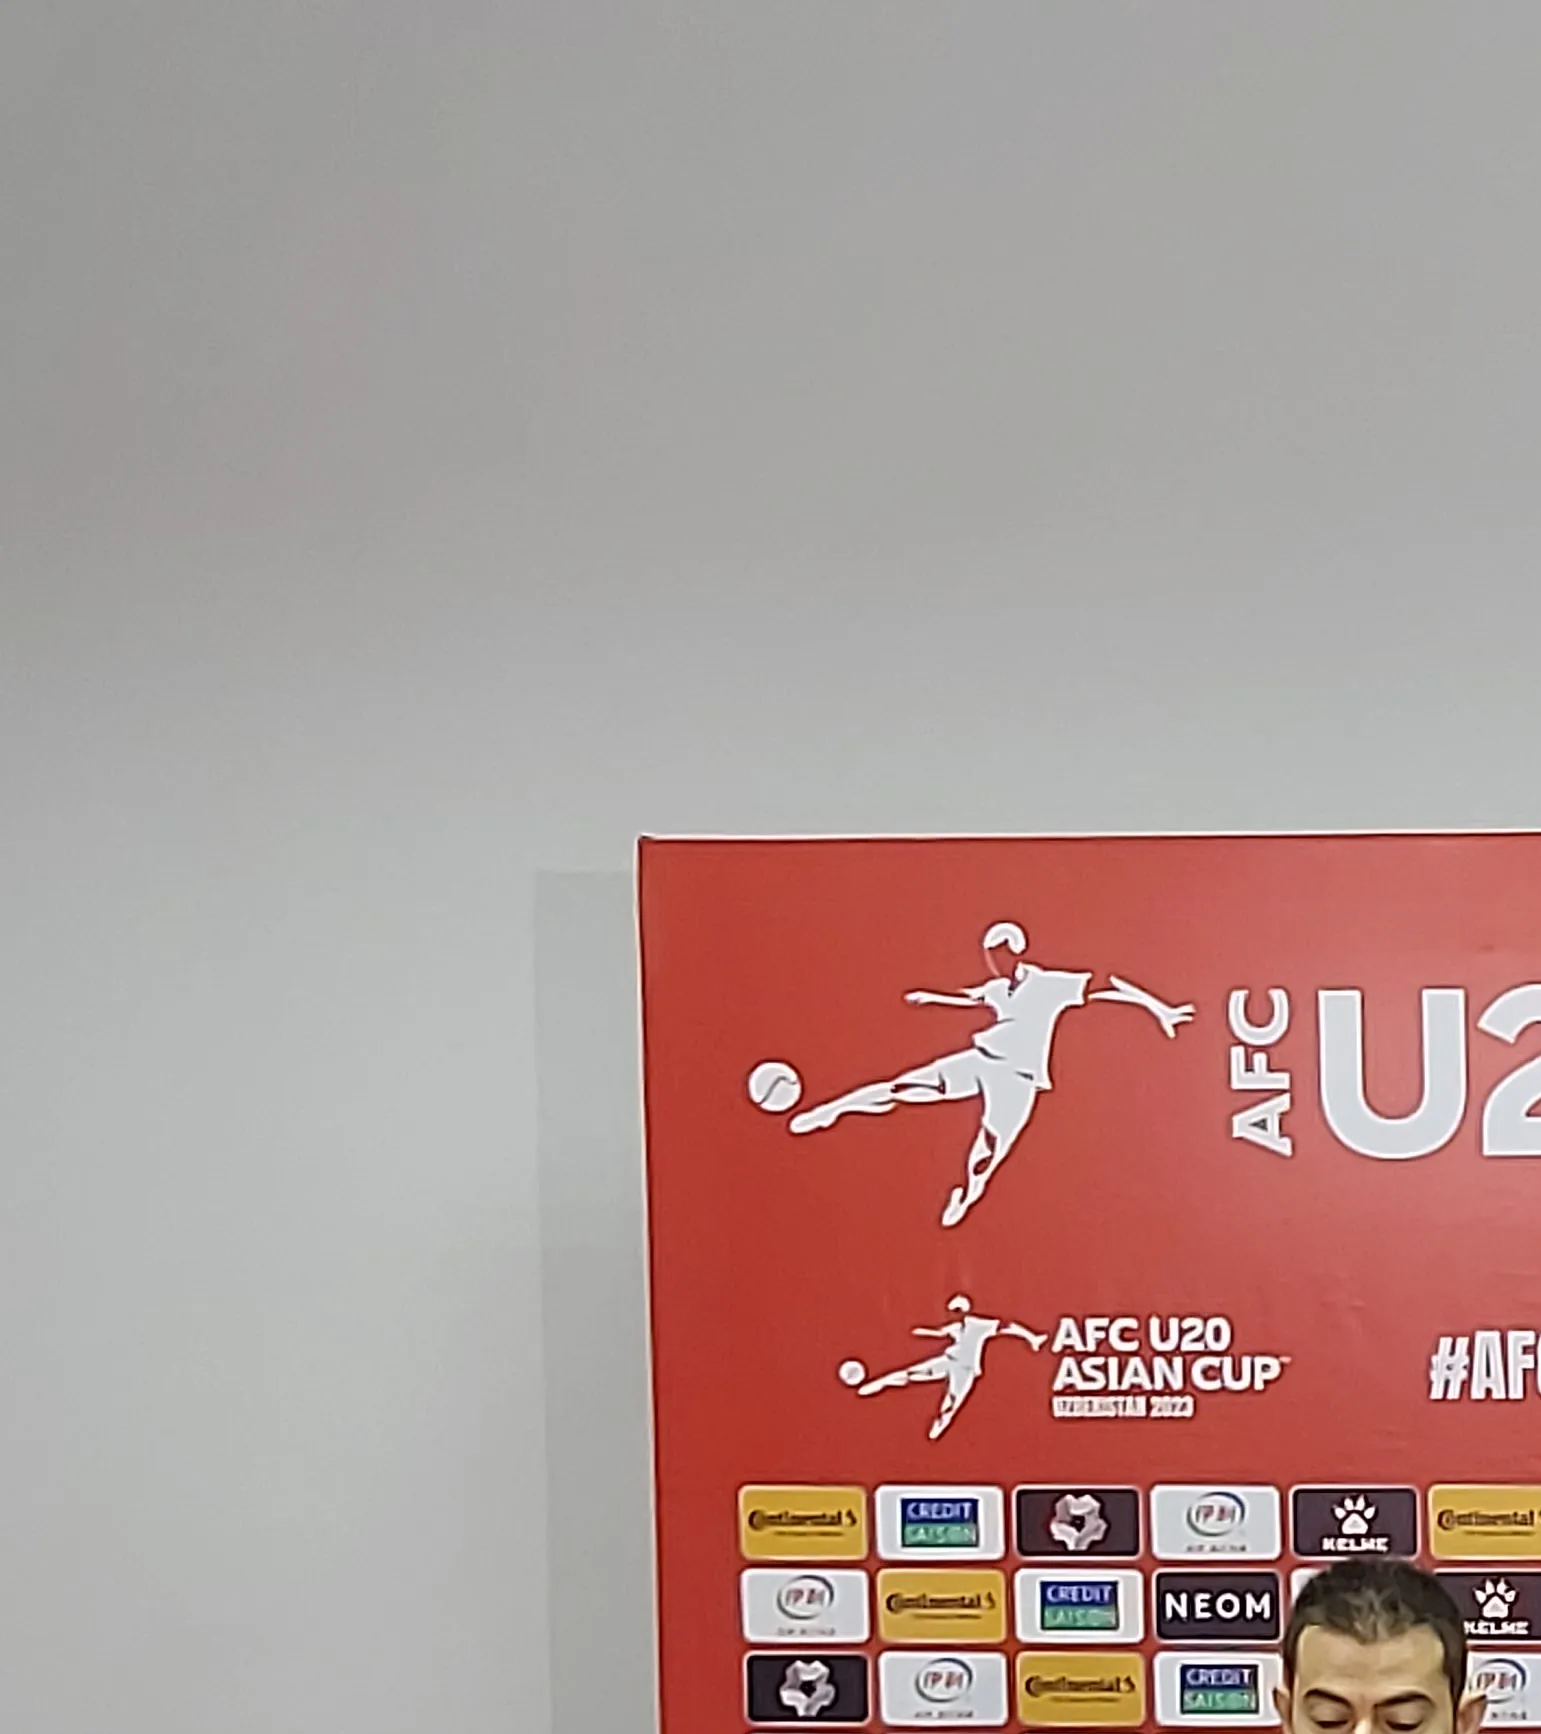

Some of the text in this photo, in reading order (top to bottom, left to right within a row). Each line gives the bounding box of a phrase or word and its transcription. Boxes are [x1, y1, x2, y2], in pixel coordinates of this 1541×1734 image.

[1229, 989, 1291, 1156] AFC
[1052, 1315, 1231, 1352] AFC U20
[1053, 1356, 1281, 1390] ASIAN CUP
[907, 1503, 972, 1520] CREDIT
[1046, 1586, 1112, 1603] CREDIT
[1166, 1593, 1270, 1618] NEOM
[1186, 1669, 1253, 1686] CREDIT
